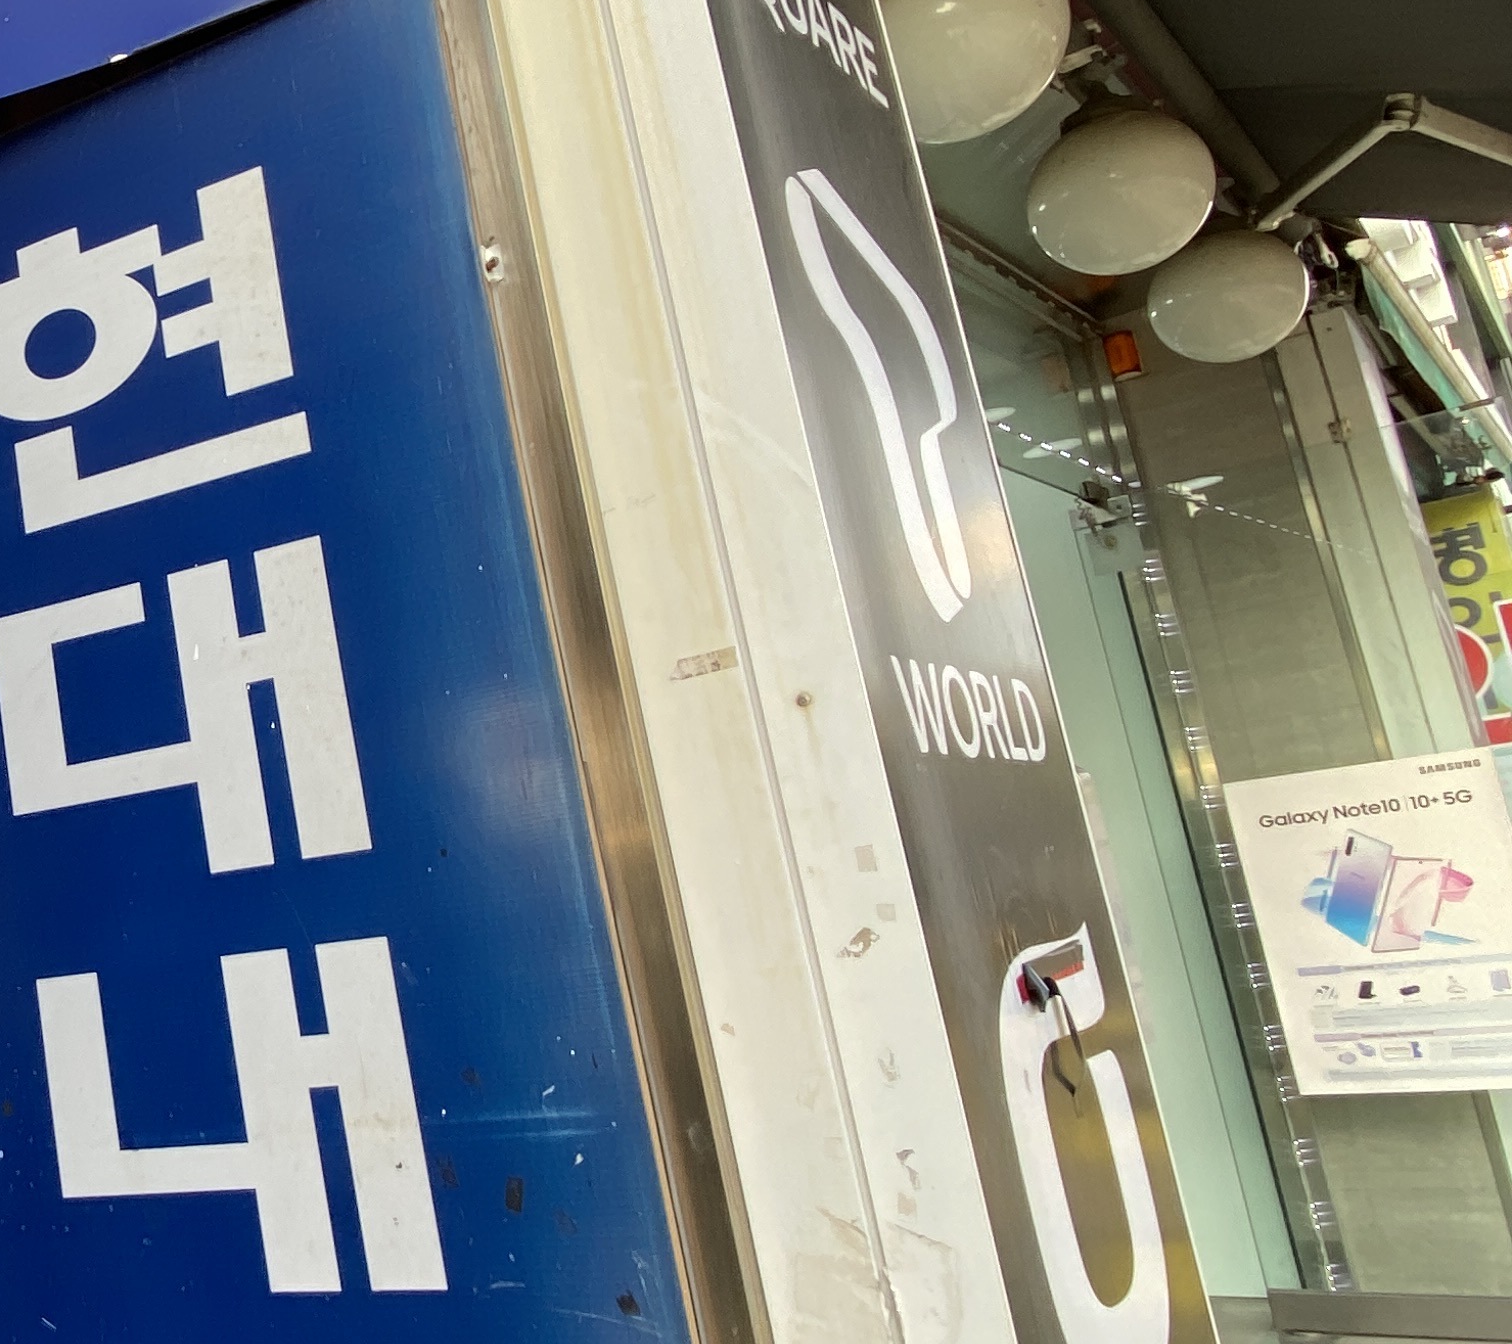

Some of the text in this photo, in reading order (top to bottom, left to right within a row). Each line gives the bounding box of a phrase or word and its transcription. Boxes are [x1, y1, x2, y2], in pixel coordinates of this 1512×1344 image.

[890, 652, 1050, 765] WORLD
[1418, 758, 1482, 775] SAMSUNG
[1258, 807, 1329, 828] Galaxy
[1332, 798, 1401, 820] Note10
[1442, 788, 1473, 805] 5G
